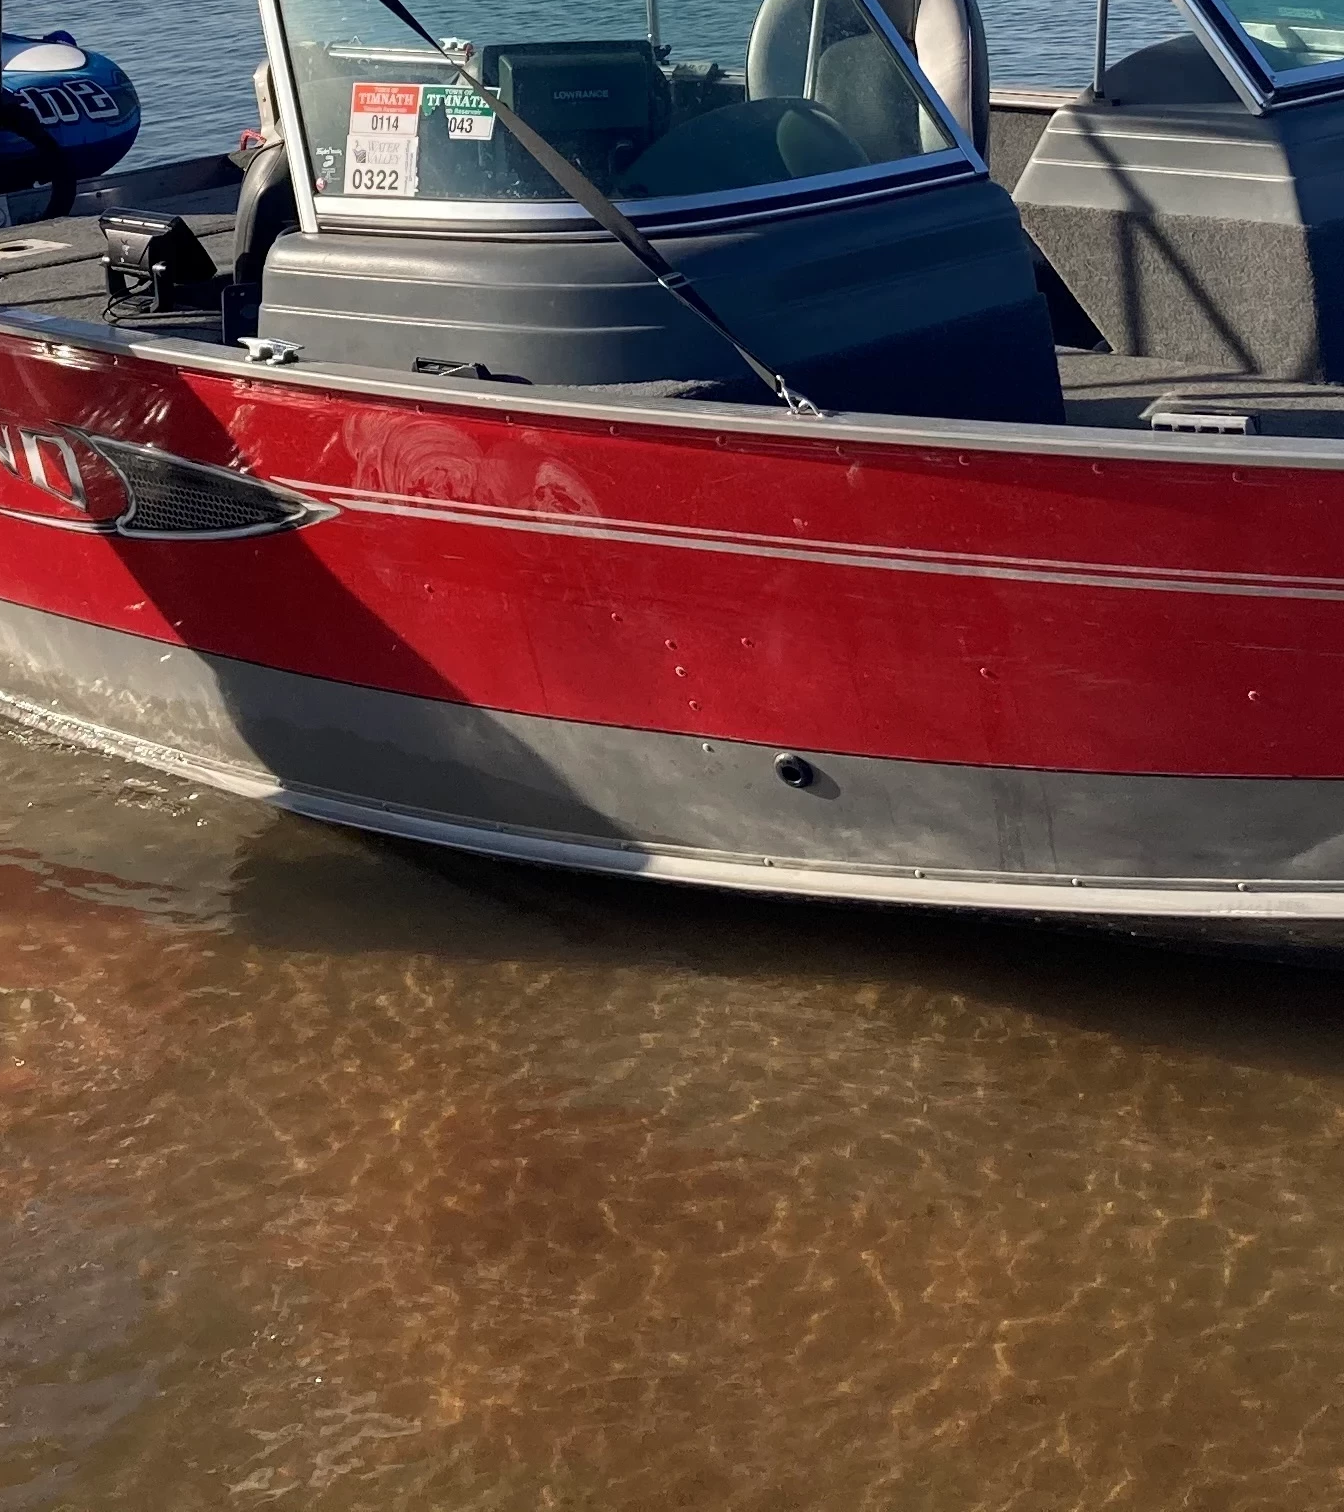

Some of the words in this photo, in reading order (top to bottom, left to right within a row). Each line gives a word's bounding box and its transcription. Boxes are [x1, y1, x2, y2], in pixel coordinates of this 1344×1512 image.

[358, 92, 415, 106] TIMNATH
[553, 89, 609, 100] LOWRANCE
[371, 114, 399, 131] 0114
[352, 168, 399, 190] 0322
